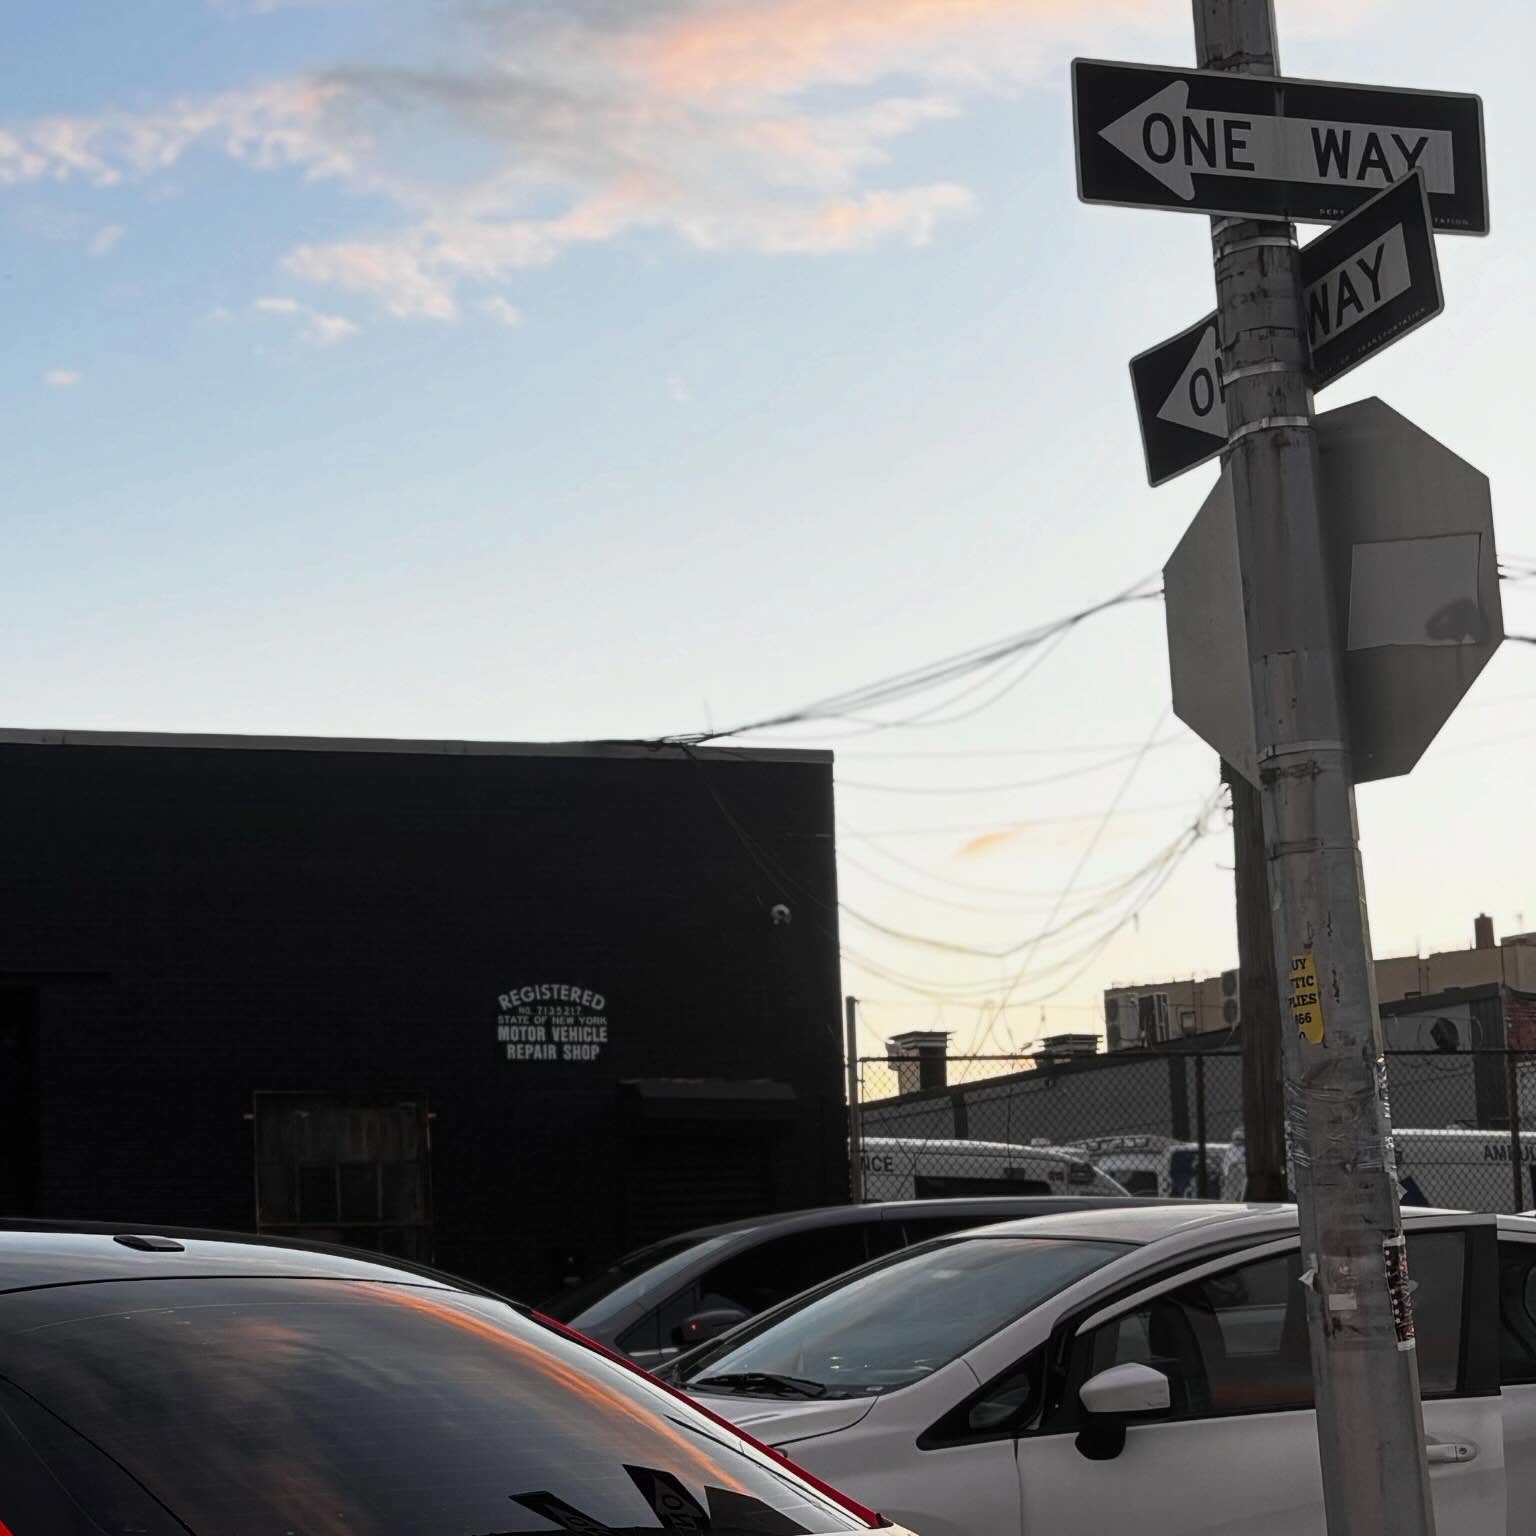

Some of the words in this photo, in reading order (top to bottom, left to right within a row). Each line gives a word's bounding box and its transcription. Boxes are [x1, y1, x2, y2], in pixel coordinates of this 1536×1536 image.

[1142, 112, 1255, 171] ONE
[1311, 127, 1428, 183] WAY
[498, 984, 606, 1011] REGISTERED
[497, 1015, 530, 1025] STATE
[534, 1015, 548, 1025] OF
[552, 1015, 574, 1025] NEW
[579, 1015, 608, 1025] YORK
[497, 1026, 546, 1043] MOTOR
[551, 1026, 608, 1043] VEHICLE
[506, 1044, 557, 1061] REPAIR
[562, 1044, 600, 1061] SHOP
